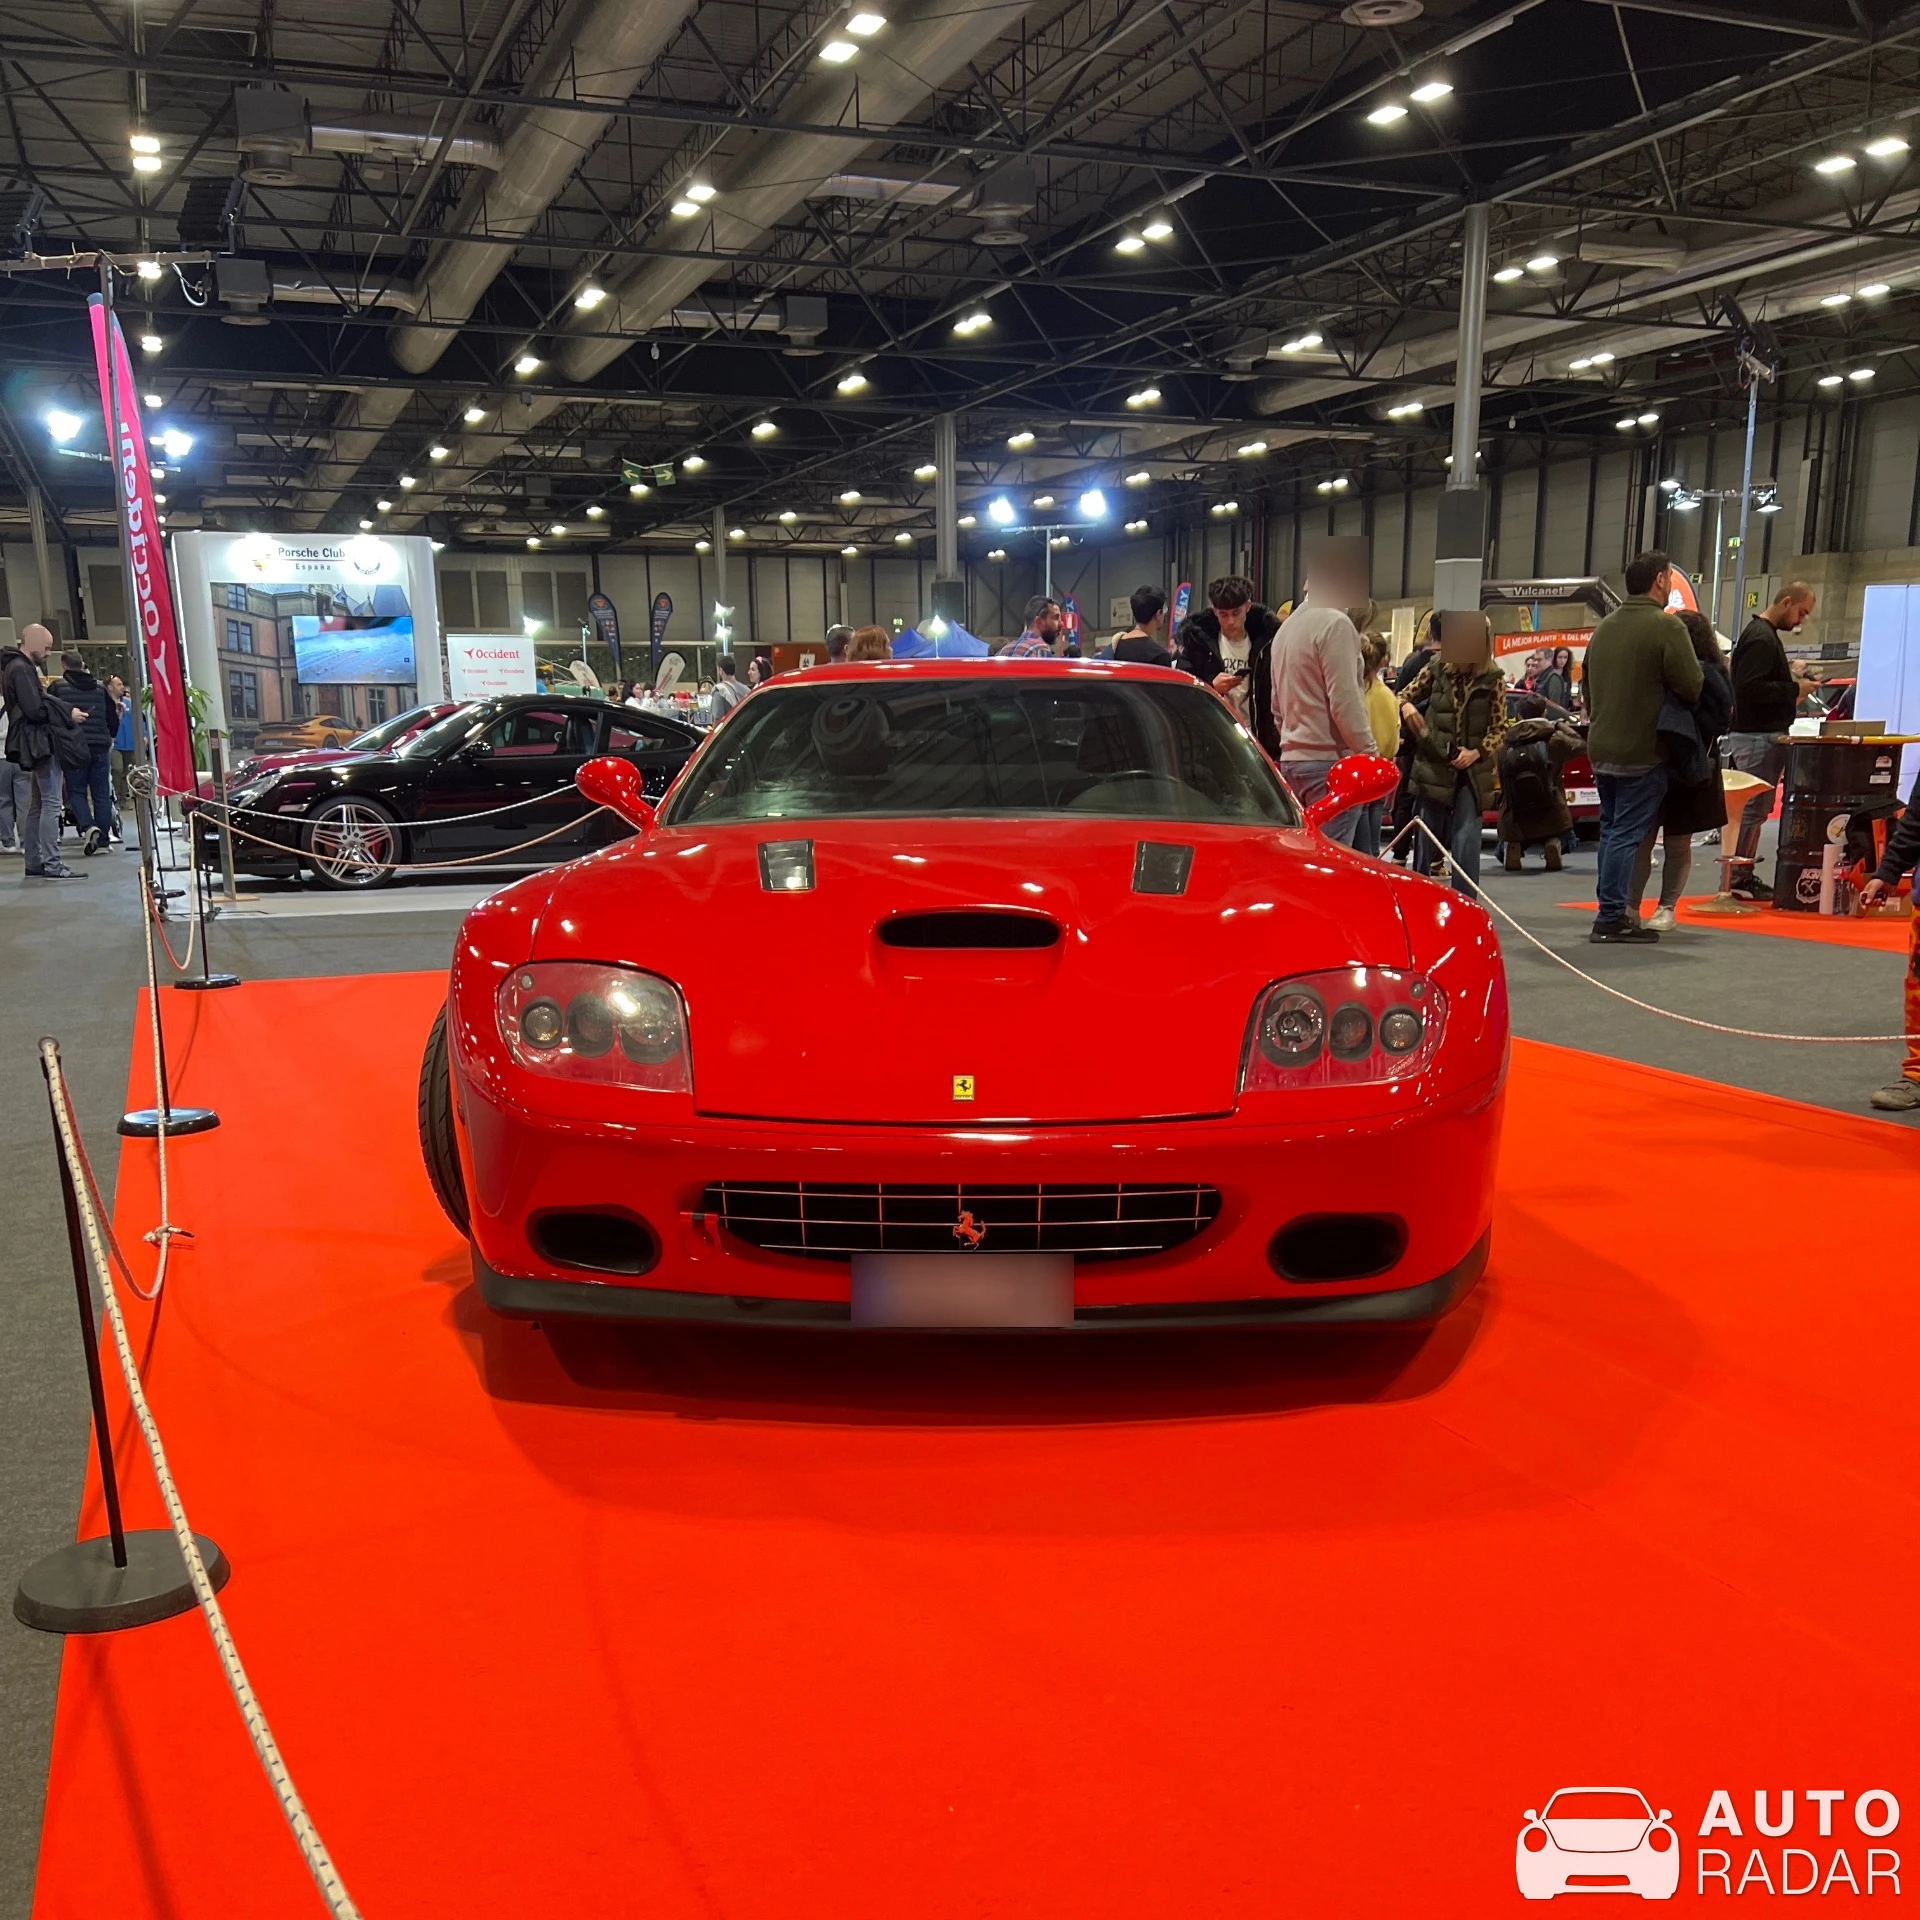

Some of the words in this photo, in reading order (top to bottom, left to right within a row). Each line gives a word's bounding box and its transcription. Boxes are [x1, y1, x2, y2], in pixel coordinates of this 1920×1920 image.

[278, 547, 319, 558] Porsche
[322, 547, 346, 558] Club
[295, 563, 331, 571] España
[1513, 586, 1565, 597] Vulcanet
[1502, 638, 1511, 650] LA
[1511, 635, 1533, 648] MEJOR
[475, 648, 520, 659] Occident
